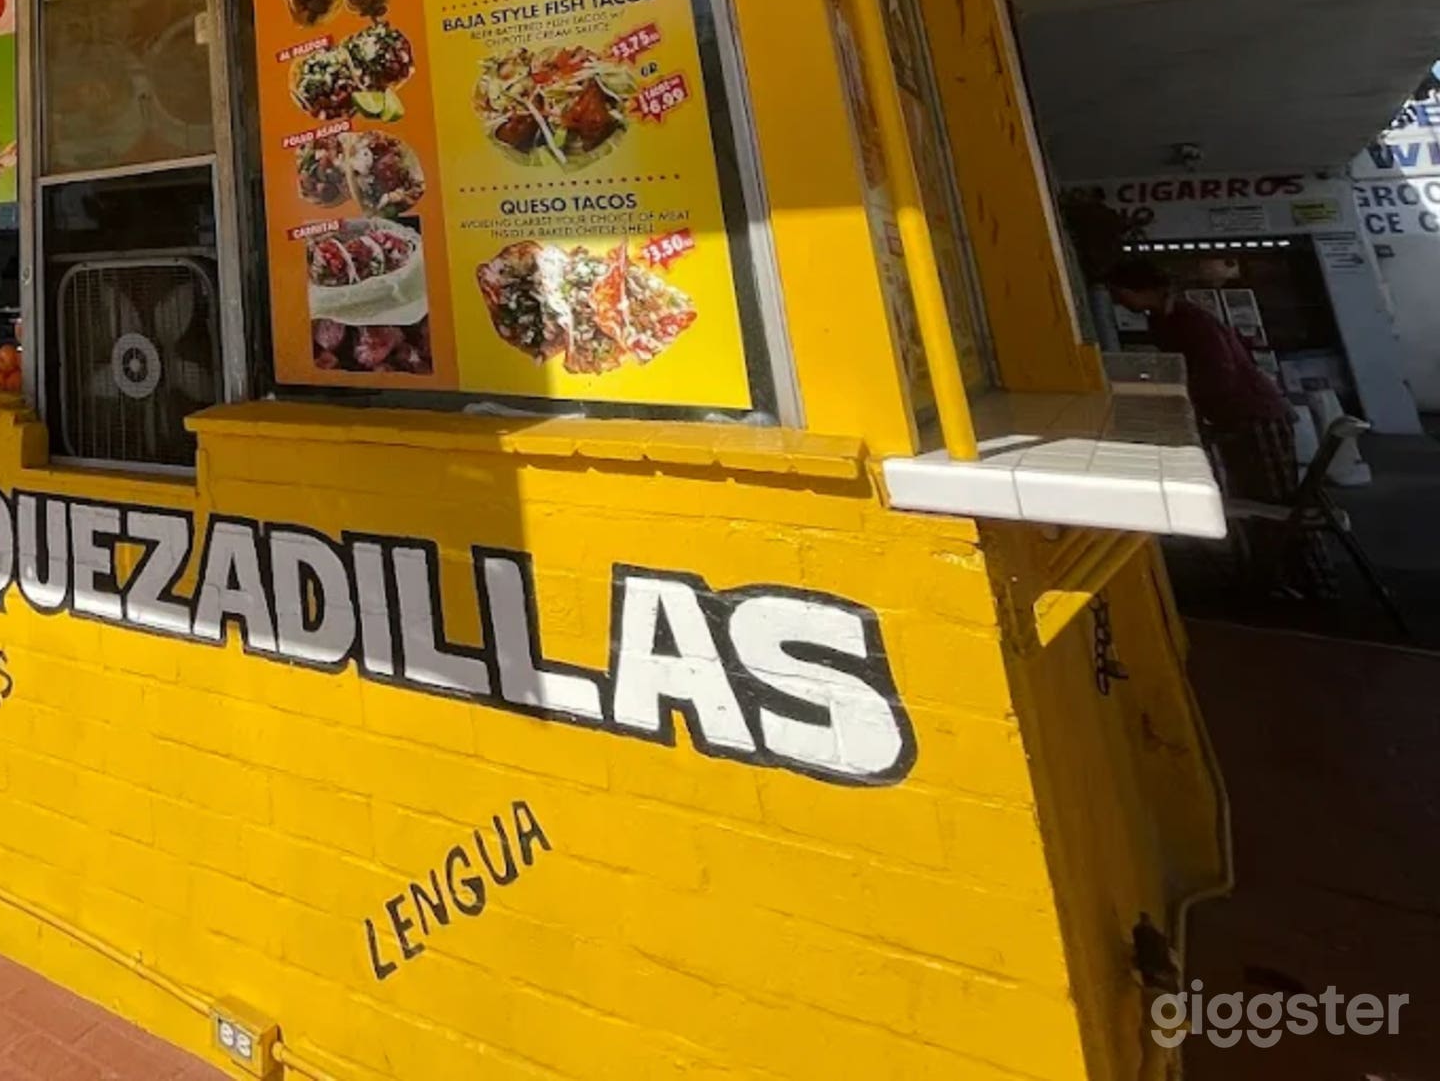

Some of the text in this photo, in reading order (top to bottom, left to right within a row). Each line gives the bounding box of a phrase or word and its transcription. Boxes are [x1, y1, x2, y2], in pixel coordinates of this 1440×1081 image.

[442, 13, 486, 32] BAJA
[490, 5, 539, 25] STYLE
[1117, 174, 1304, 204] CIGARROS
[500, 193, 637, 216] QUESO TACOS
[364, 799, 553, 982] LENGUA
